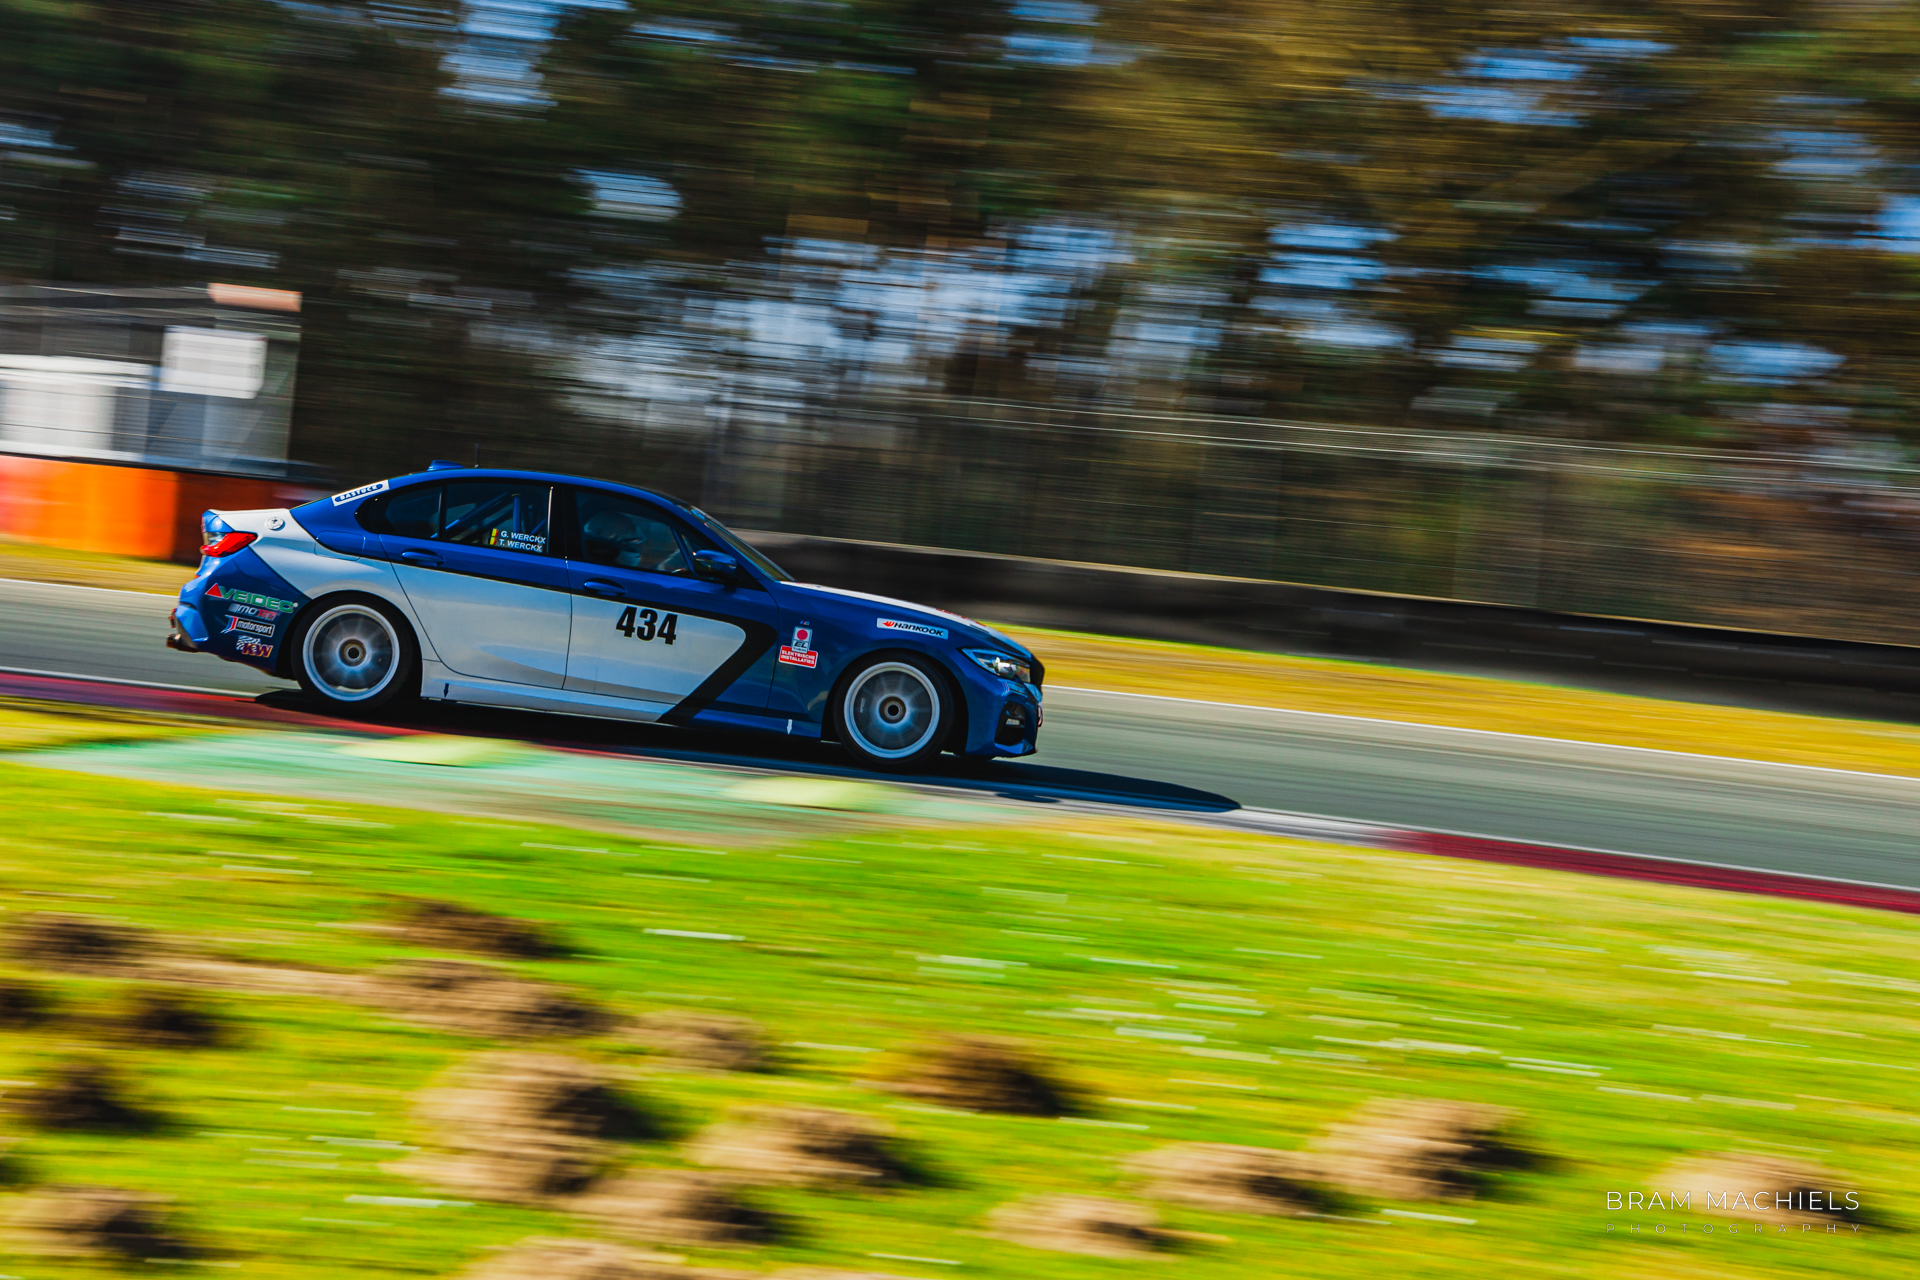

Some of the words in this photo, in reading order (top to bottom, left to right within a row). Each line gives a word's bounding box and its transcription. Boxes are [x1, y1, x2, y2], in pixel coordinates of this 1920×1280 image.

[500, 530, 509, 539] G.
[511, 532, 546, 545] WERCKX
[507, 540, 543, 553] WERCKX
[219, 586, 294, 613] VEIDEC
[616, 605, 679, 646] 434
[242, 643, 274, 658] KW
[781, 650, 816, 660] ELEKTRISCHE
[780, 654, 815, 664] INSTALLATIES
